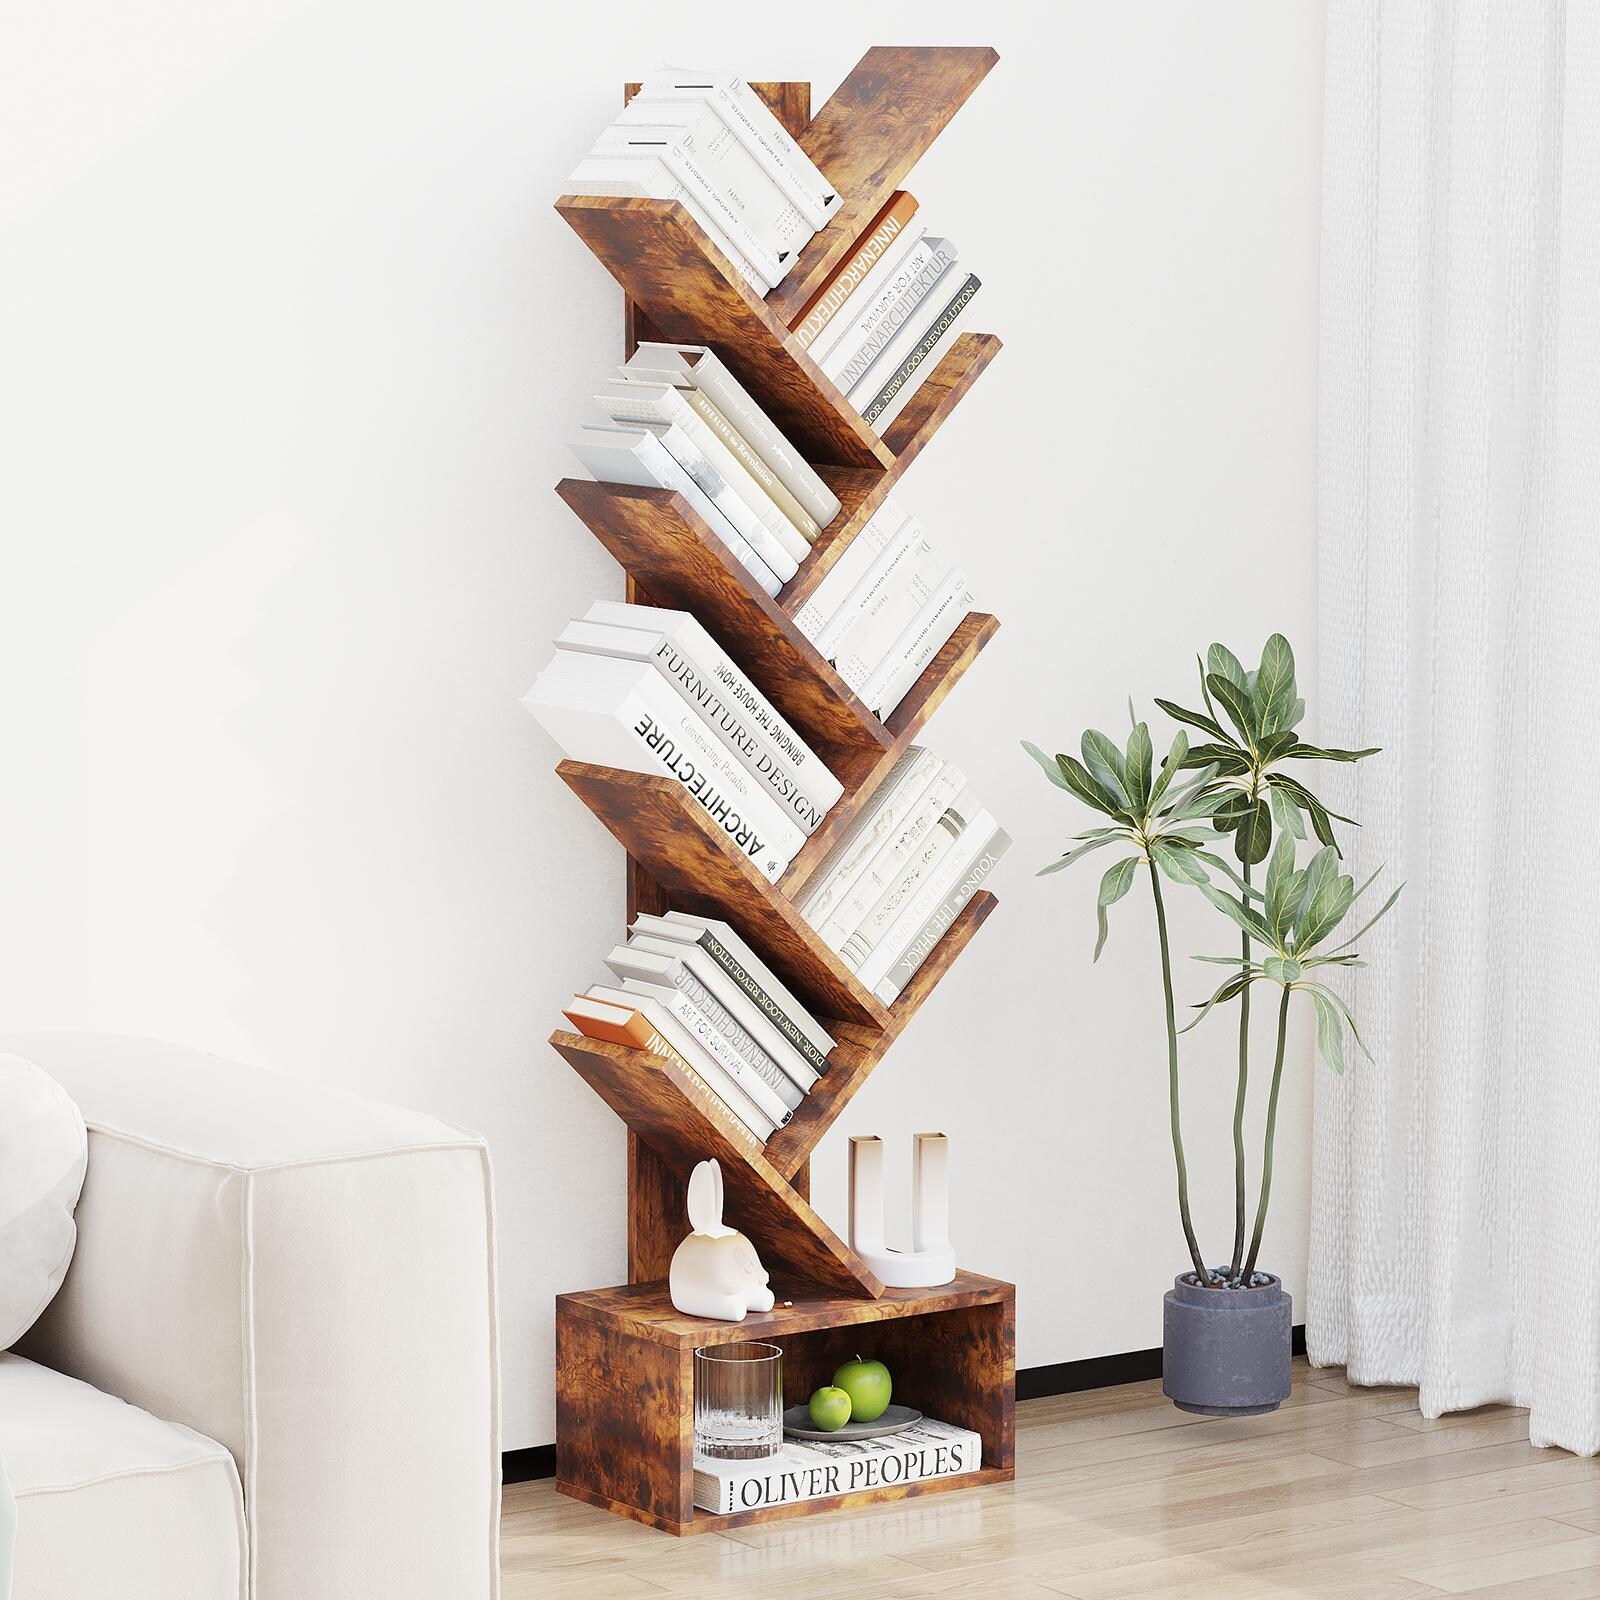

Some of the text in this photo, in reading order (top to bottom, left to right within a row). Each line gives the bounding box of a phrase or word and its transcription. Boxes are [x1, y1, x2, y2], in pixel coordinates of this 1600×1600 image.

[841, 249, 950, 386] INNENARCHITEKTUR
[861, 255, 924, 333] ART FOR SURVIVAL
[883, 376, 903, 402] NEW
[901, 349, 926, 377] LOOK
[925, 285, 976, 350] REVOLUTION
[698, 399, 731, 438] REVEALING
[737, 443, 774, 488] Revolution
[655, 642, 821, 828] FURNITURE DESIGN
[680, 716, 721, 768] Constructing
[713, 661, 805, 766] BRINGING THE HOUSE HOME
[634, 712, 765, 856] ARCHITECTURE
[932, 903, 958, 932] THE
[961, 852, 998, 897] YOUNG
[901, 927, 938, 974] SHACK
[674, 967, 785, 1090] INNENARCHITEKTUR
[678, 1003, 745, 1075] ART FOR SURVIVAL
[707, 938, 825, 1067] DIOR. NEW LOOK REVOLUTION
[741, 1465, 840, 1507] OLIVER
[848, 1444, 963, 1490] PEOPLES
